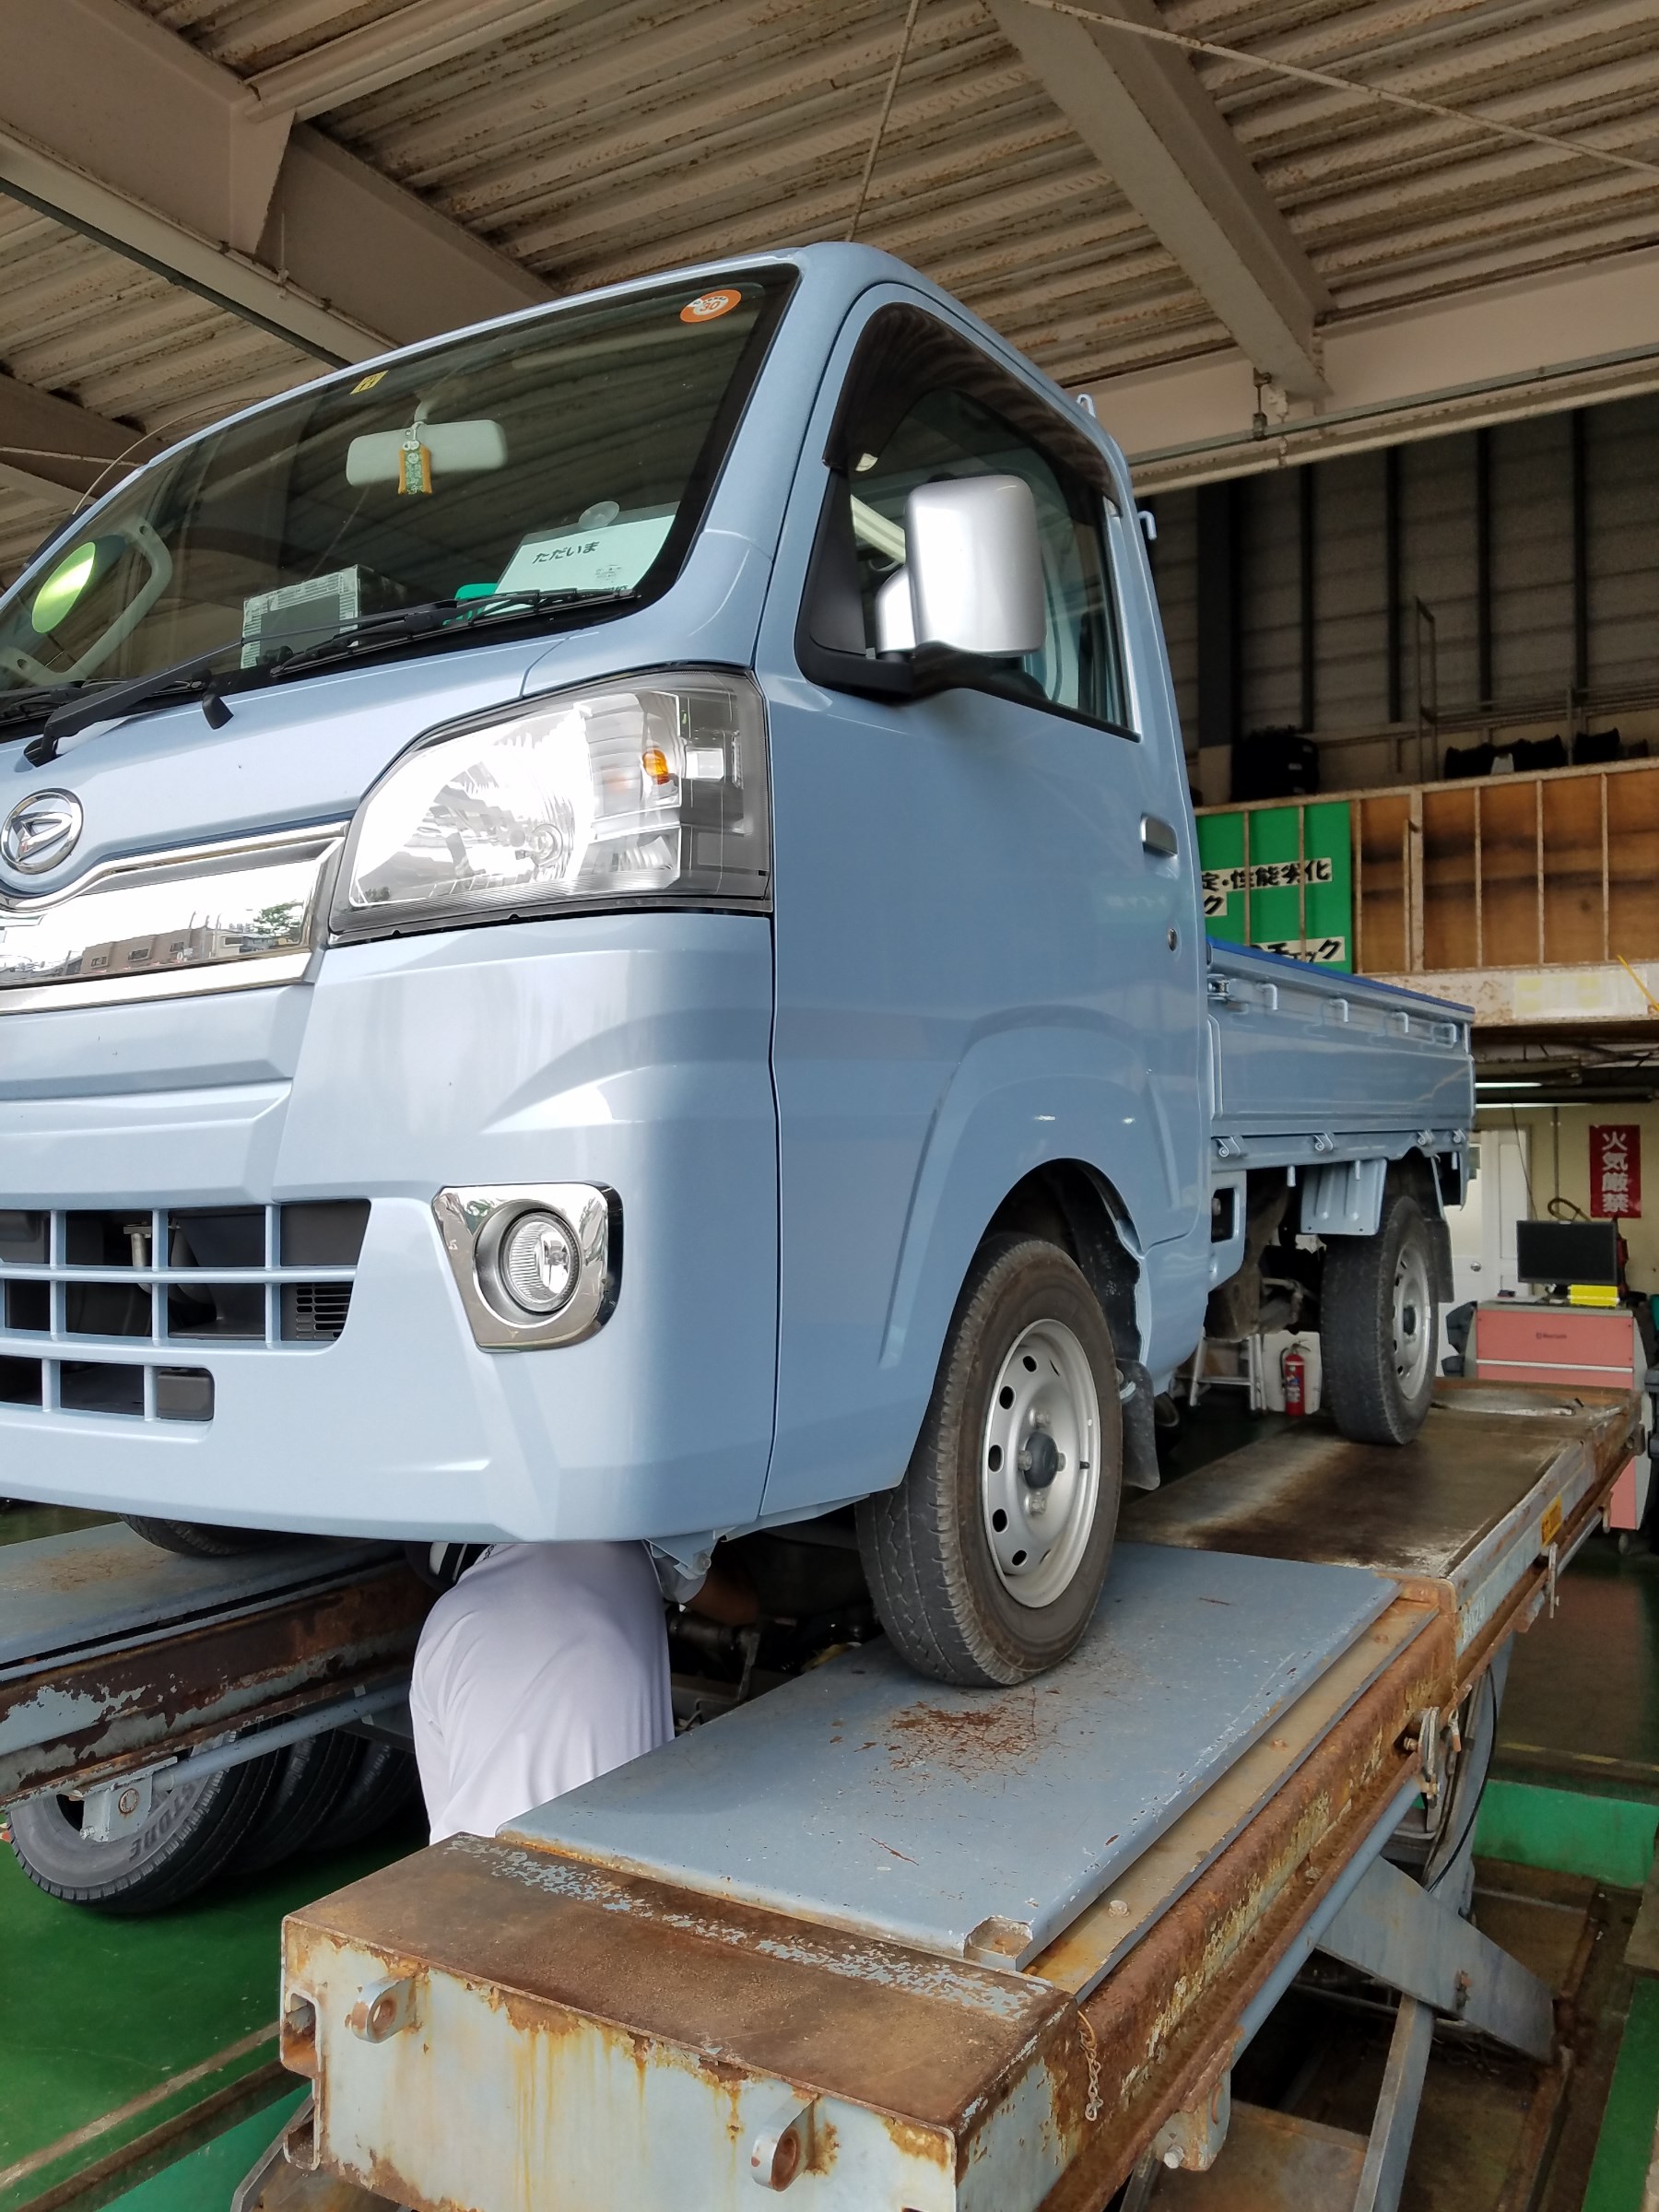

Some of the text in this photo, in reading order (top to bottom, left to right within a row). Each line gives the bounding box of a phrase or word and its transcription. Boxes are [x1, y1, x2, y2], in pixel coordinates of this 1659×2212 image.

[532, 541, 600, 564] ただいま
[1204, 895, 1224, 915] ク
[1602, 1131, 1629, 1213] 火気厳禁
